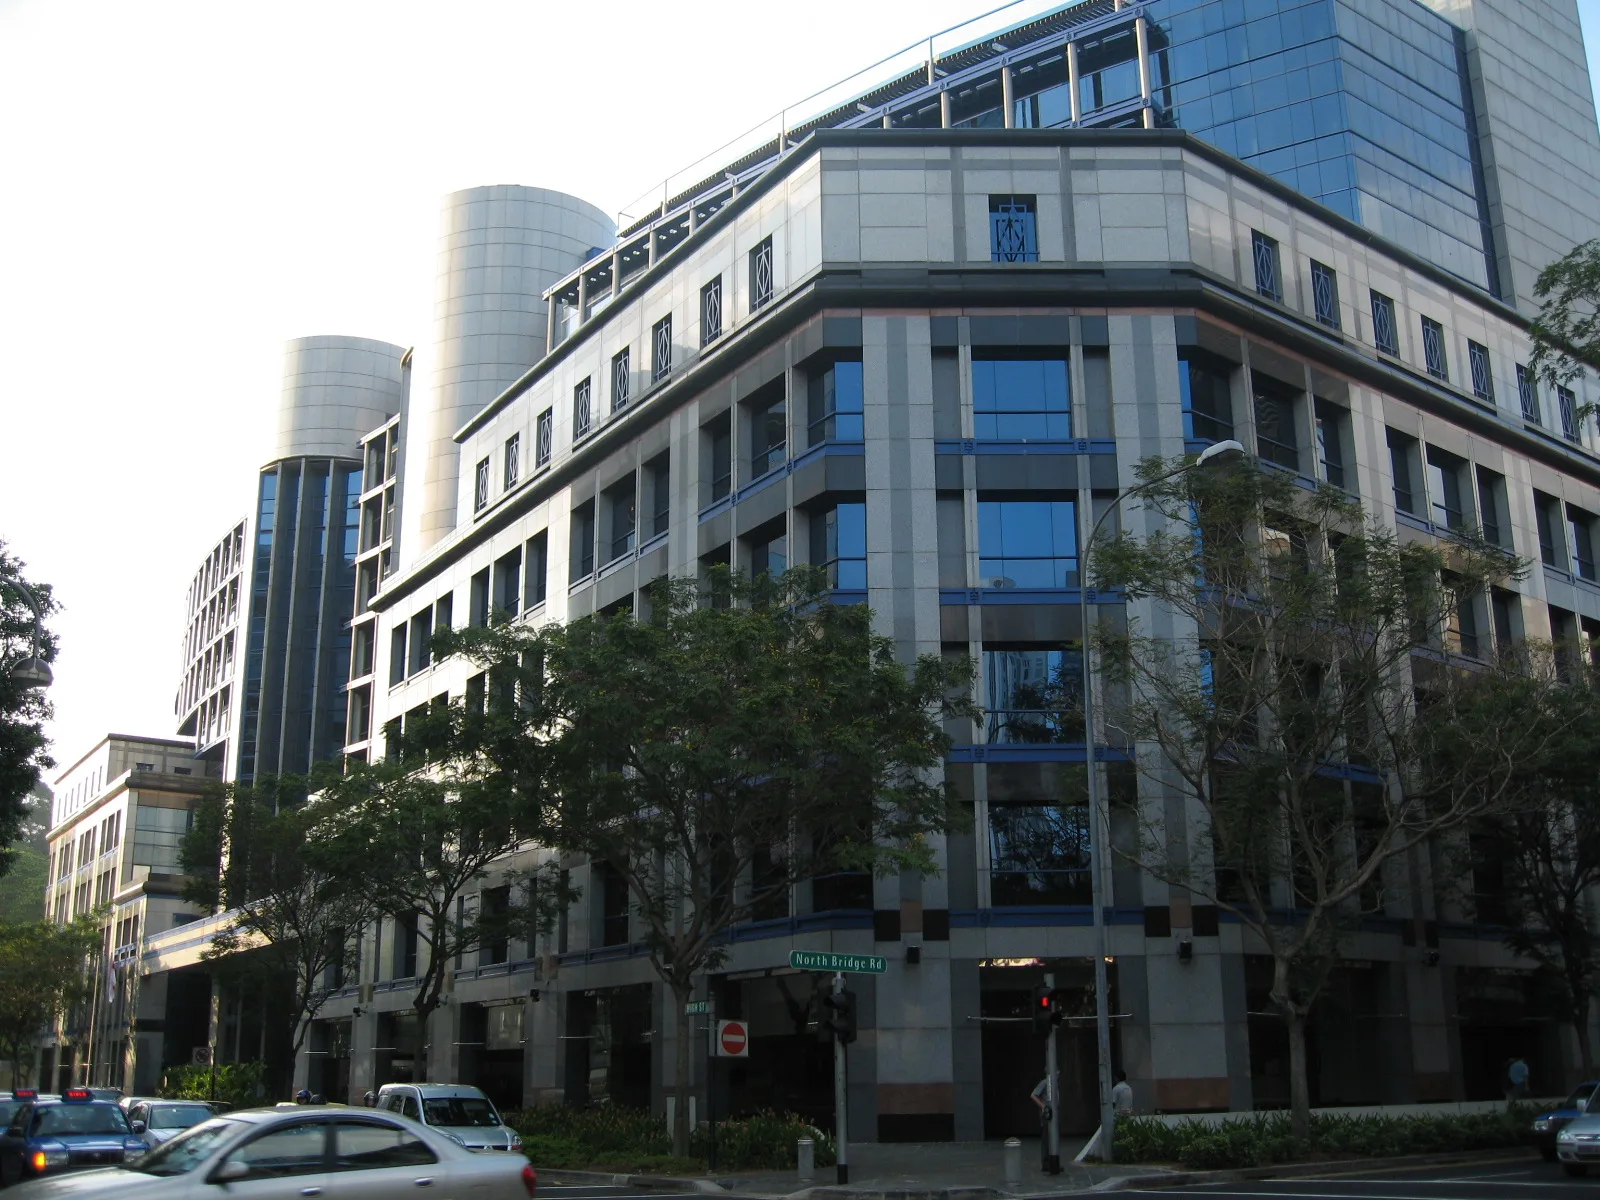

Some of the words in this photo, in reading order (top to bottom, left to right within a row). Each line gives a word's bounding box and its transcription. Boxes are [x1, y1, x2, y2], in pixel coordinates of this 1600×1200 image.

[796, 953, 827, 966] North
[831, 956, 866, 970] Bridge
[870, 959, 882, 969] Rd
